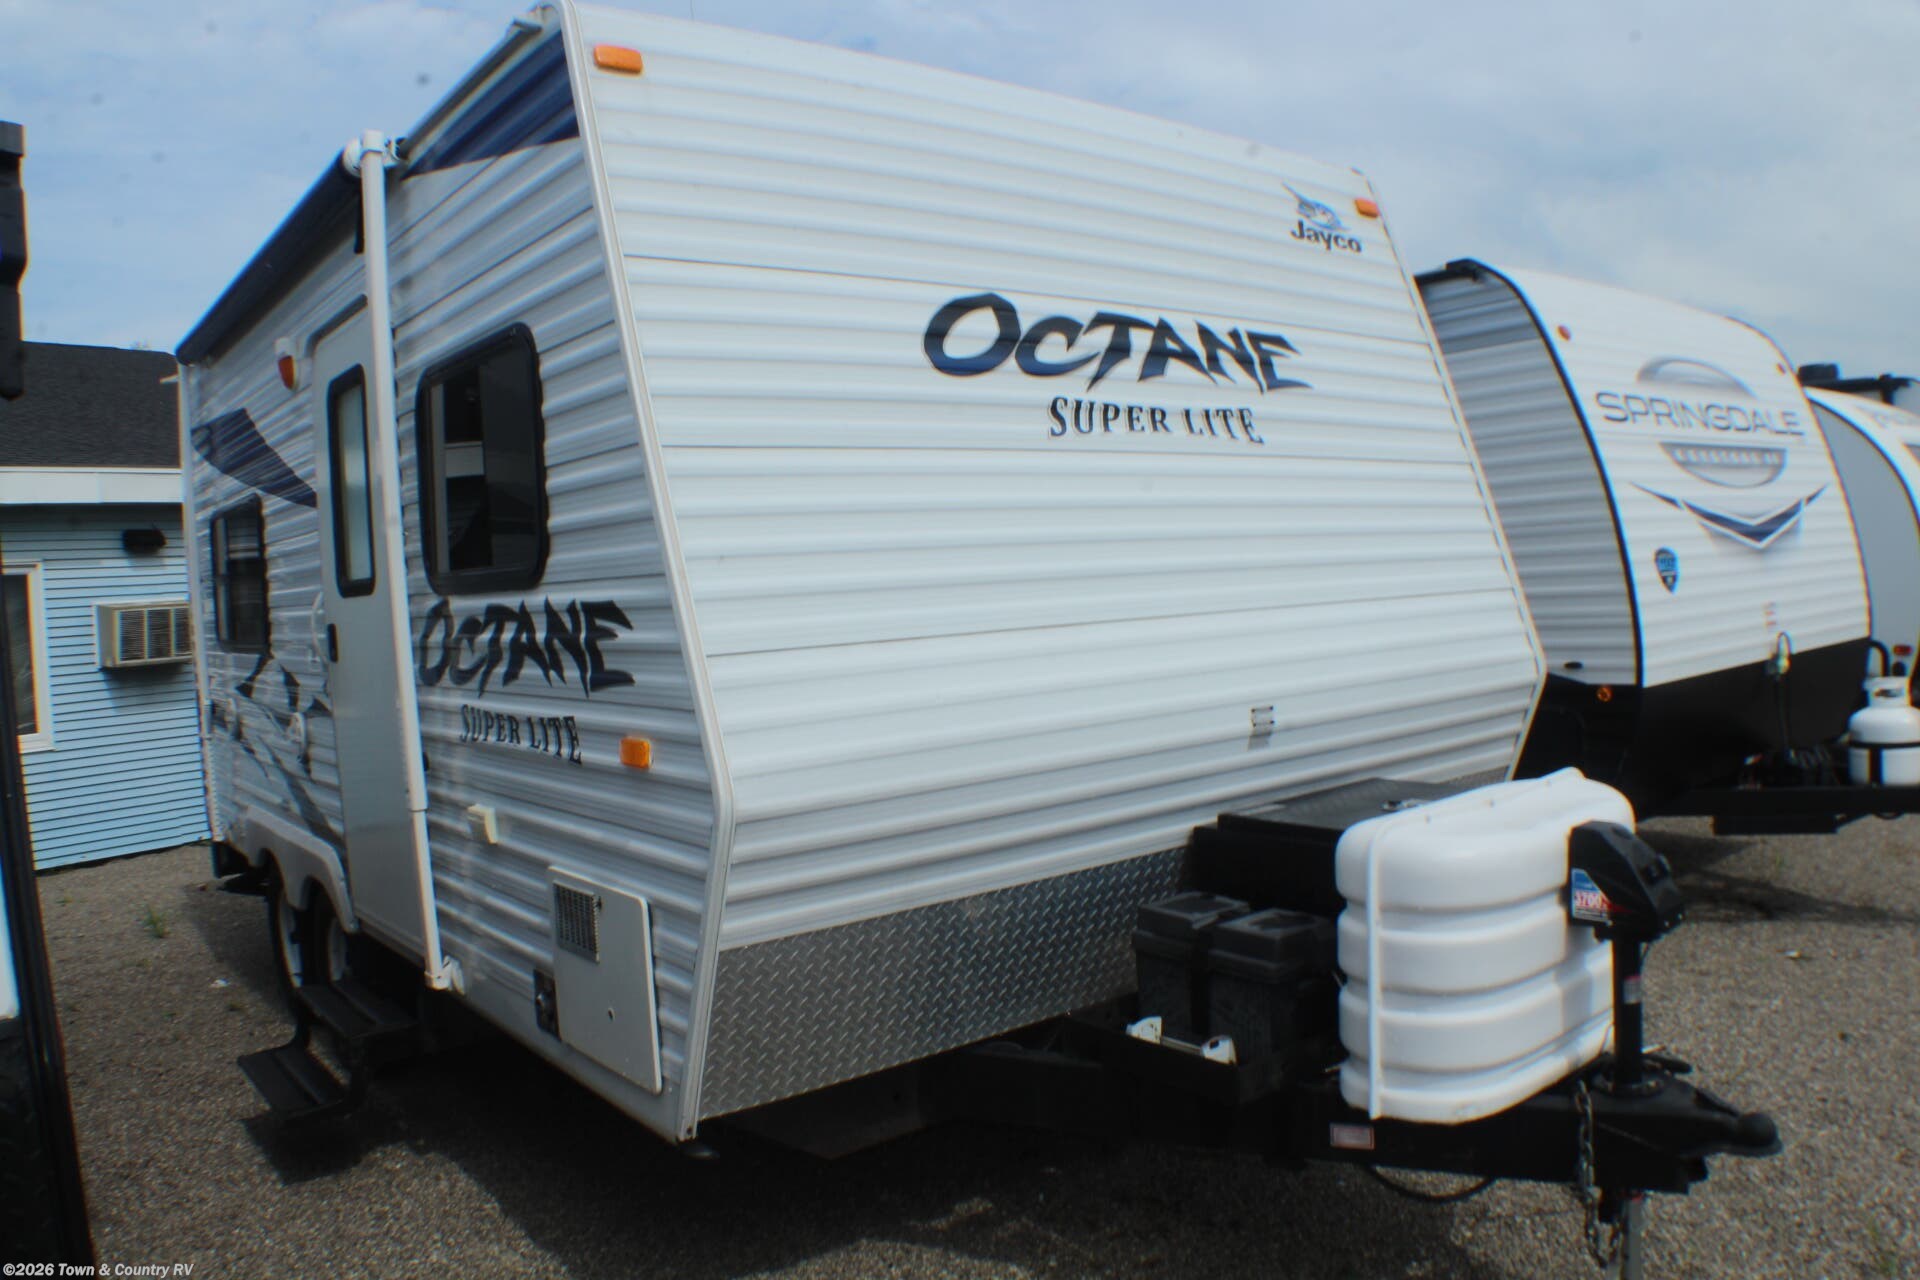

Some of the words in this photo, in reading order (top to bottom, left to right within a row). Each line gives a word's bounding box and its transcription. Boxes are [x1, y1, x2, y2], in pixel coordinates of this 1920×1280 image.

[1290, 219, 1361, 252] Jayco
[924, 292, 1312, 395] OCTANE
[1048, 396, 1172, 439] SUPER
[1183, 407, 1265, 445] LITE
[1595, 391, 1805, 436] SPRINGDALE
[419, 596, 636, 699] OCTANE
[460, 704, 521, 743] SUPER
[527, 715, 582, 766] LITE
